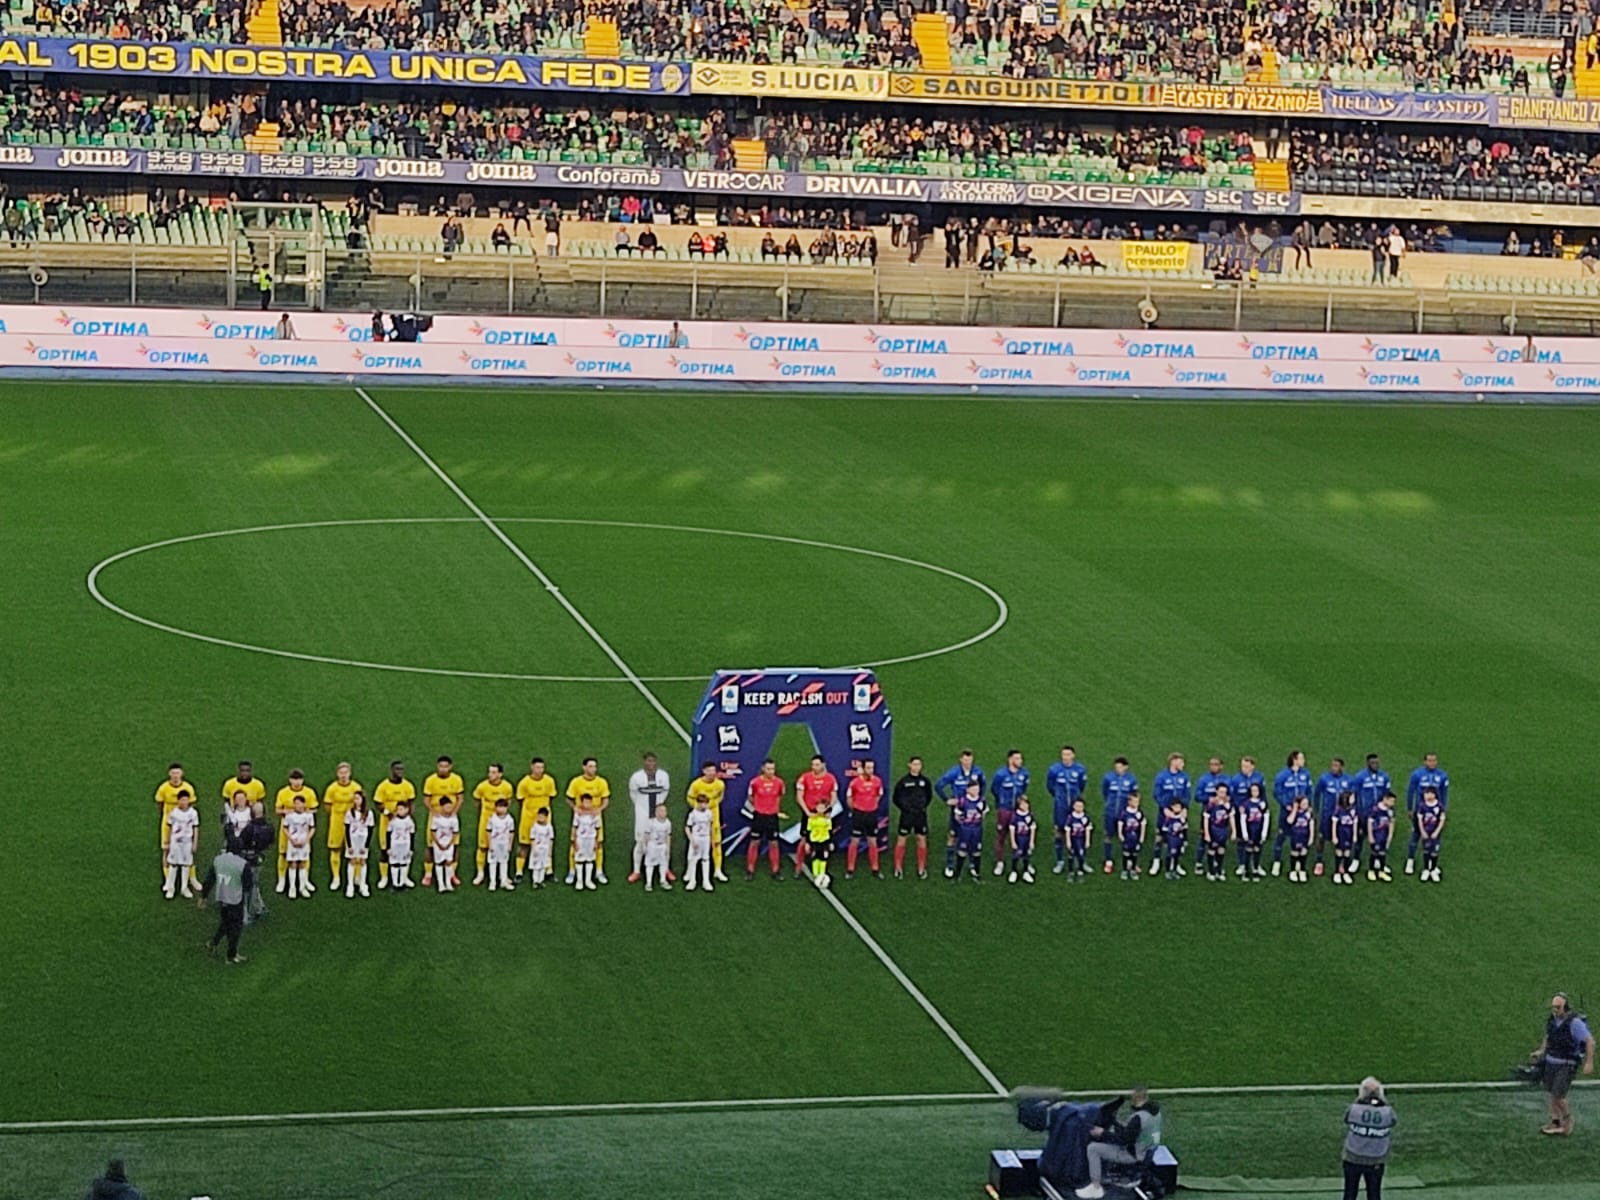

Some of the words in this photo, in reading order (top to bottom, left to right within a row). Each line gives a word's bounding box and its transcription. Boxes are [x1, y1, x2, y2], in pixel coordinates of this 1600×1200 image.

[69, 43, 175, 72] 1903
[191, 48, 375, 78] NOSTRA
[391, 55, 527, 83] UNICA
[541, 61, 651, 88] FEDE
[923, 78, 1129, 101] SANGUINETTO
[1178, 91, 1232, 108] CASTEL
[1233, 92, 1307, 111] D'AZZANO
[1332, 95, 1395, 110] HELLAS
[1511, 97, 1588, 121] GIANFRANCO
[557, 166, 662, 187] Conforama
[682, 170, 786, 191] VETROCAR
[806, 175, 924, 197] DRIVALIA
[1204, 190, 1242, 204] SEC
[1252, 191, 1290, 206] SEC
[1135, 245, 1176, 256] PAULO
[72, 322, 149, 336] OPTIMA
[214, 325, 277, 339] OPTIM
[485, 331, 558, 345] OPTIMA
[750, 336, 820, 351] OPTIMA
[879, 339, 948, 353] OPTIMA
[1006, 340, 1074, 355] OPTIMA
[1127, 343, 1195, 358] OPTIMA
[1252, 345, 1318, 360] OPTIMA
[37, 349, 98, 362] OPTIMA
[149, 351, 209, 364] OPTIMA
[259, 354, 318, 366] OPTIMA
[1375, 348, 1441, 361] OPTIMA
[1496, 350, 1562, 363] OPMA
[364, 356, 422, 368] OPTIMA
[471, 358, 527, 370] OPTIMA
[576, 360, 632, 373] OPTIMA
[679, 362, 735, 375] OPTIMA
[781, 364, 836, 377] OPTIMA
[882, 366, 936, 379] OPTIMA
[979, 368, 1033, 380] OPTIMA
[1077, 369, 1131, 381] OPTIMA
[1175, 371, 1227, 383] OPTIMA
[1272, 372, 1325, 384] OPTIMA
[1369, 374, 1420, 386] OPTIMA
[1464, 375, 1516, 387] OPTIMA
[1555, 377, 1600, 387] OPTIM
[744, 692, 775, 705] KEEP
[778, 692, 823, 705] RACISM
[826, 692, 848, 704] OUT
[217, 873, 231, 885] TV
